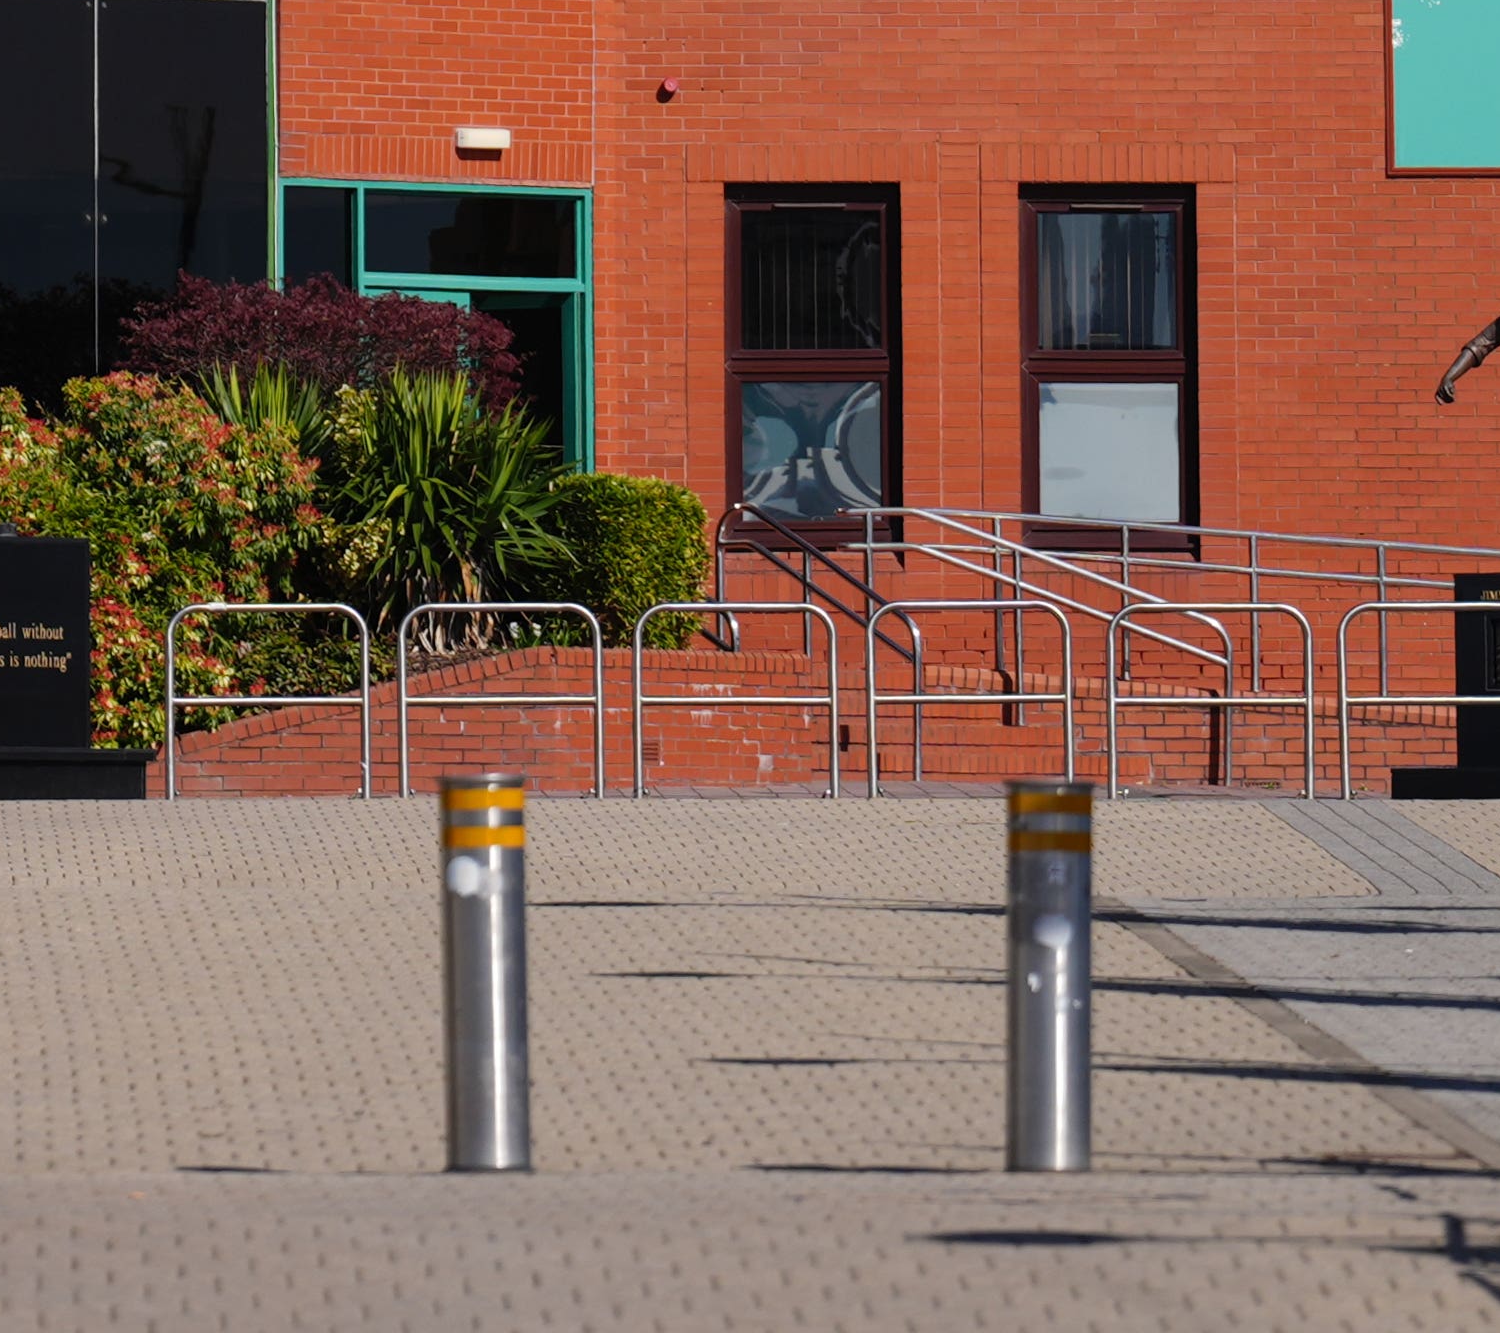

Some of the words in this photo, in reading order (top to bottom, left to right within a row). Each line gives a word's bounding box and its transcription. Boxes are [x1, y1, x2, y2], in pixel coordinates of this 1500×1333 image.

[22, 622, 64, 641] without
[9, 650, 20, 668] is
[24, 650, 73, 674] nothing"
